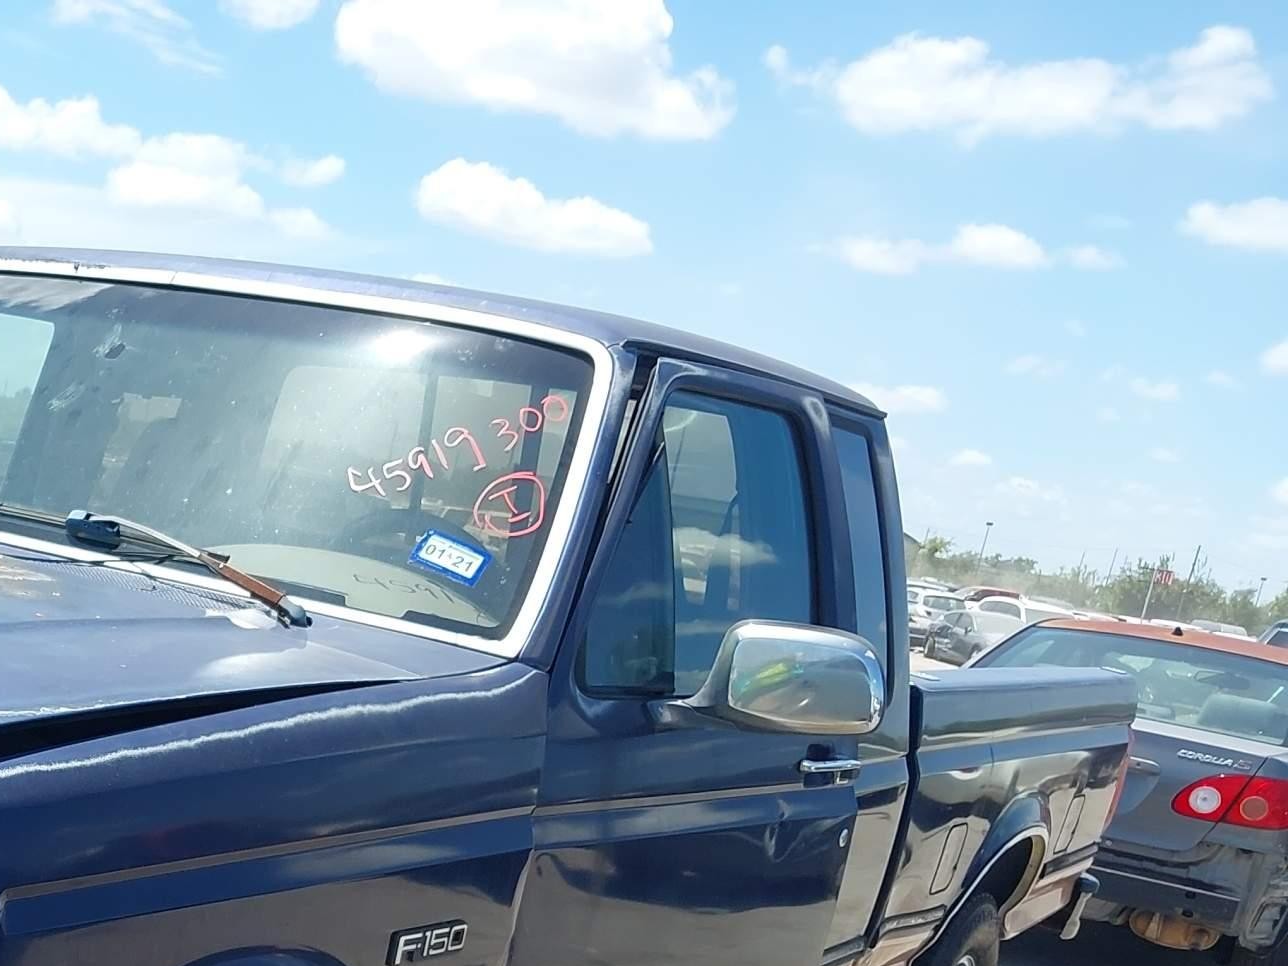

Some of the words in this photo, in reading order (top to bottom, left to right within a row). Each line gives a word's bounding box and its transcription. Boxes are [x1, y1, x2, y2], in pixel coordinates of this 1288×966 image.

[347, 427, 486, 497] 45919
[489, 395, 568, 451] 300
[1176, 748, 1233, 767] COROLLA
[394, 923, 468, 966] F-150
